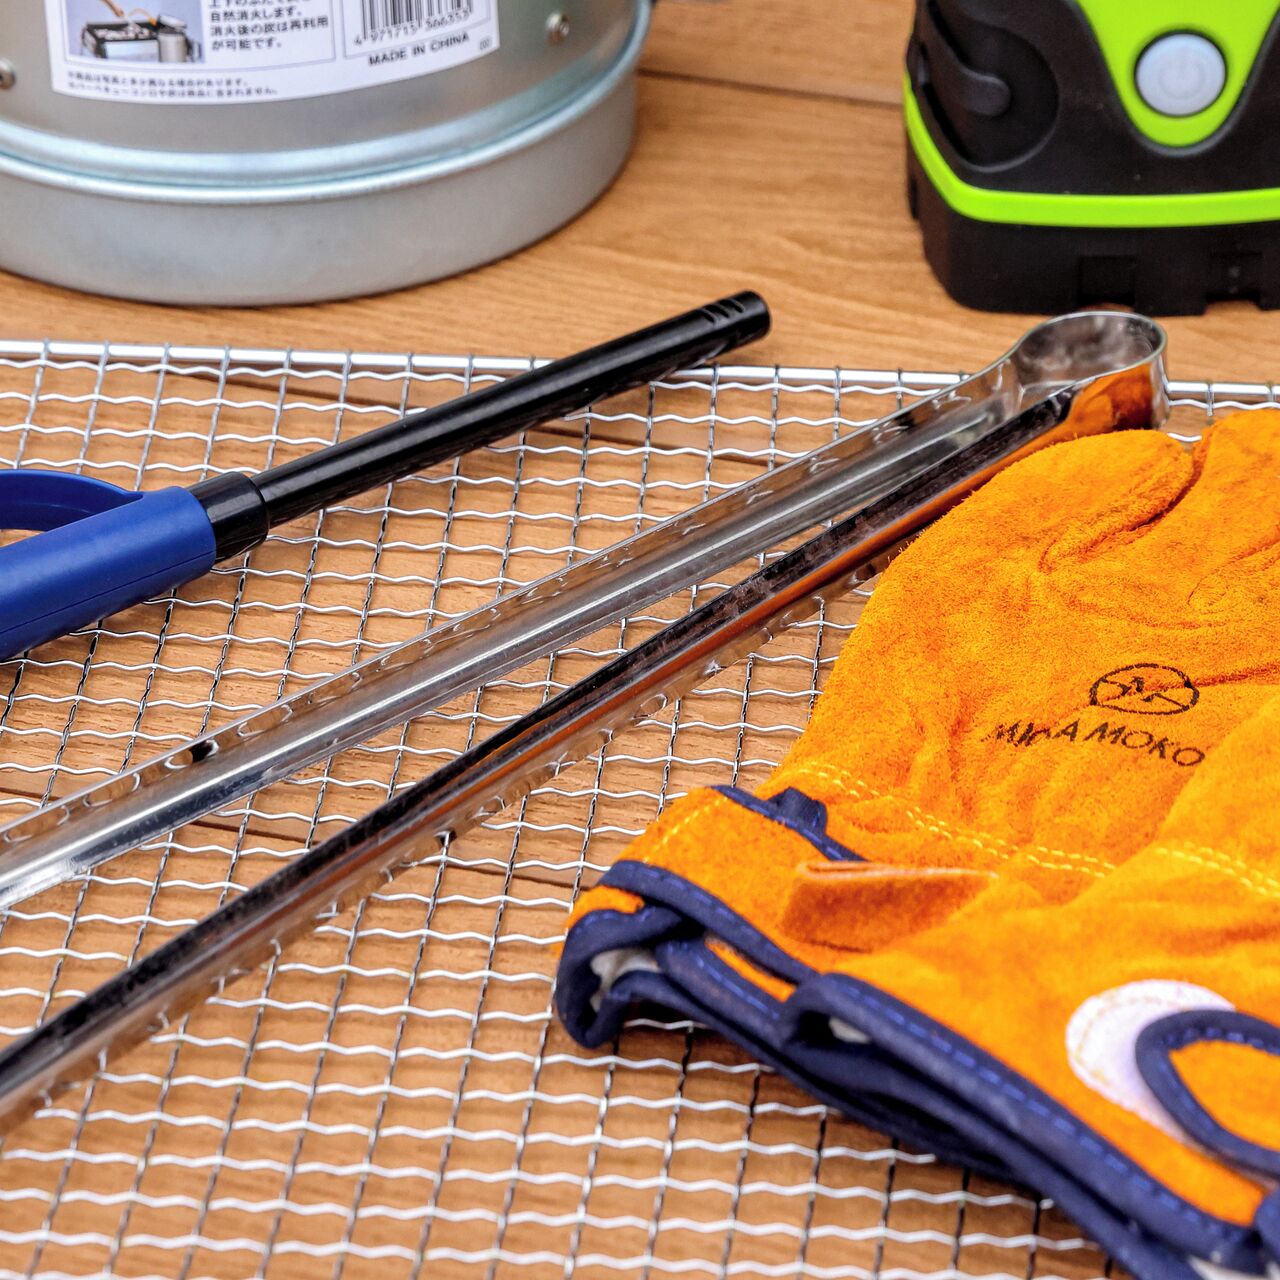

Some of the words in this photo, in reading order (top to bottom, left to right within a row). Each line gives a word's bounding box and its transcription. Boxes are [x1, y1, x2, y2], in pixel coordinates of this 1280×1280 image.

[211, 15, 328, 36] 消火後の炭は再利用
[369, 47, 407, 65] MADE
[412, 43, 426, 57] IN
[430, 32, 470, 51] CHINA
